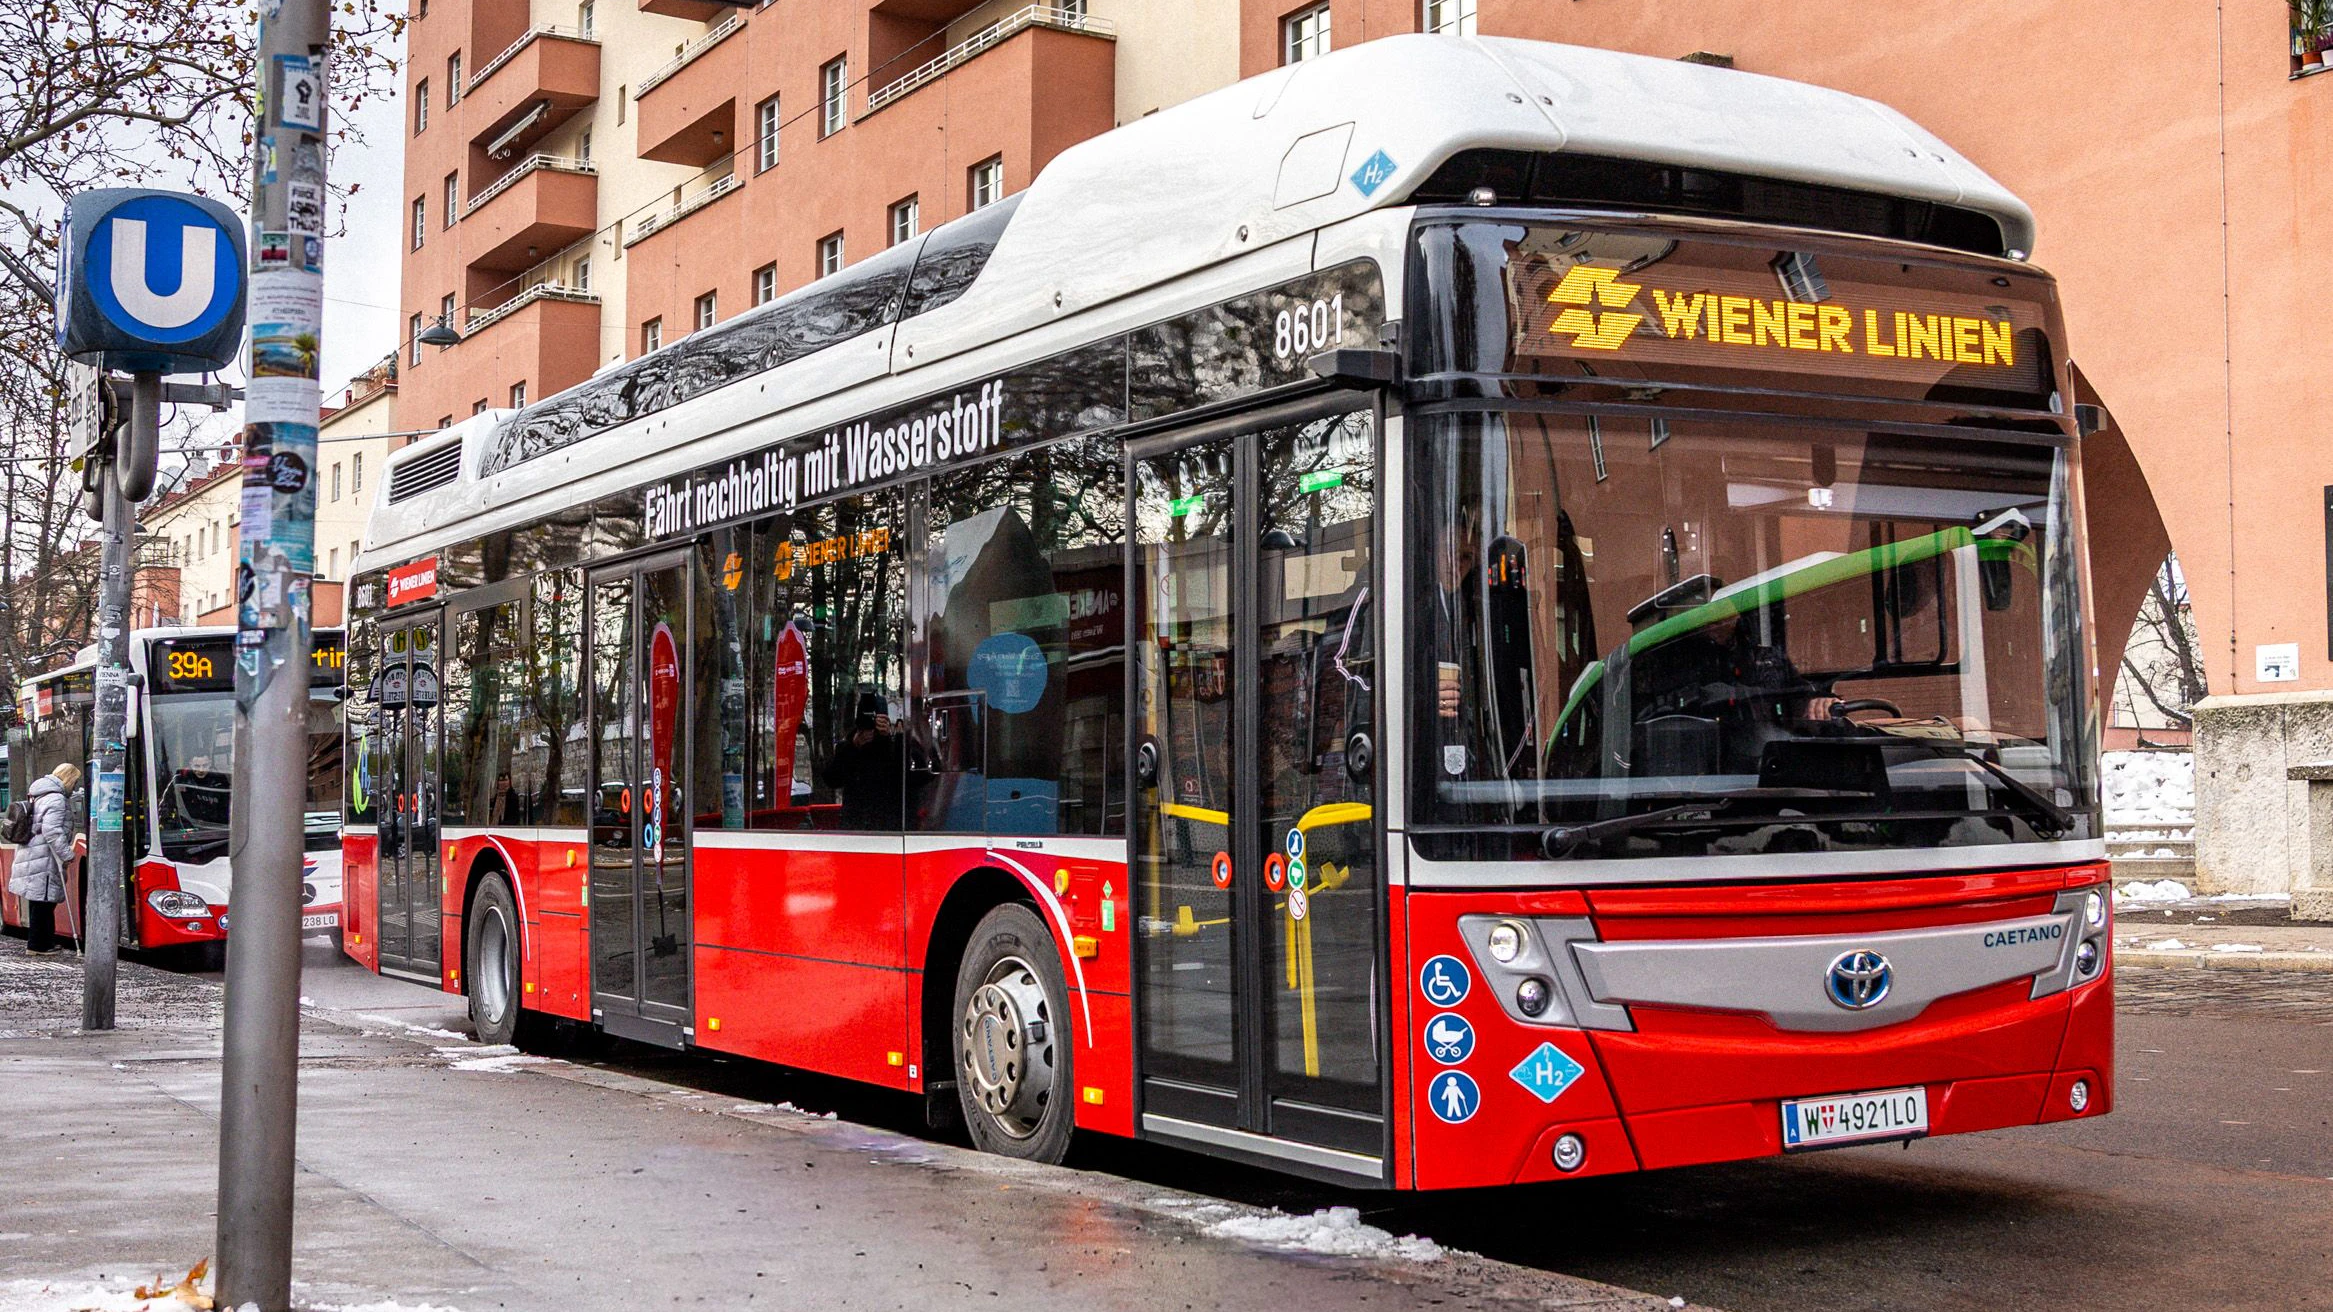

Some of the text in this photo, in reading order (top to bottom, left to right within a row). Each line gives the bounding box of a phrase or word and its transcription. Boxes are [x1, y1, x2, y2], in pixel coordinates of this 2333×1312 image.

[110, 218, 216, 329] U
[1276, 293, 1343, 359] 8601
[1652, 288, 2014, 366] WIENER LINIEN
[645, 380, 1003, 540] Fährt nachhaltig mit Wasserstoff
[400, 569, 435, 592] WIENER LINIEN
[168, 651, 213, 679] 39A
[303, 916, 321, 927] 238
[1984, 924, 2062, 948] CAETANO
[985, 1019, 998, 1081] CAETANO
[1535, 1061, 1564, 1086] H2
[1790, 1128, 1797, 1137] A
[1804, 1106, 1819, 1136] W
